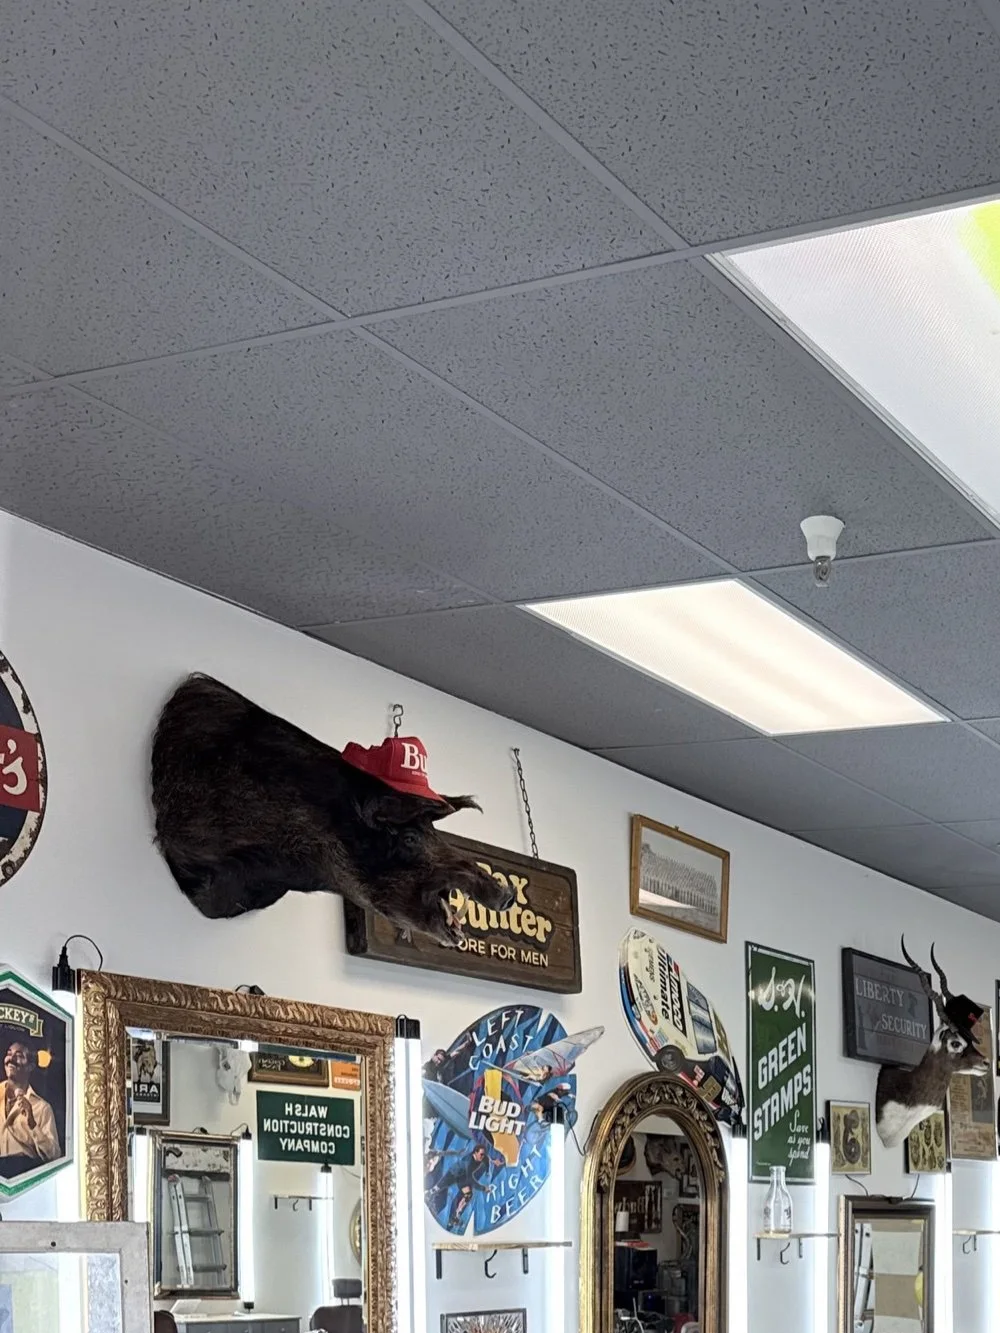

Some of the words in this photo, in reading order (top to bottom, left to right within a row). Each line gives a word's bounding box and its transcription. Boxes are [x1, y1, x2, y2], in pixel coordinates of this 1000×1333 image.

[459, 938, 486, 955] ORE
[490, 943, 516, 961] FOR
[521, 950, 549, 968] MEN
[855, 976, 905, 1007] LIBERTY
[471, 1008, 525, 1047] LEFT
[881, 1014, 927, 1040] SECURITY
[468, 1034, 534, 1071] COAST
[757, 1022, 807, 1091] GREEN
[478, 1094, 522, 1119] BUD
[753, 1063, 813, 1142] STAMPS
[468, 1113, 526, 1137] LIGHT
[486, 1145, 543, 1203] RIGHT
[490, 1176, 544, 1225] BEER
